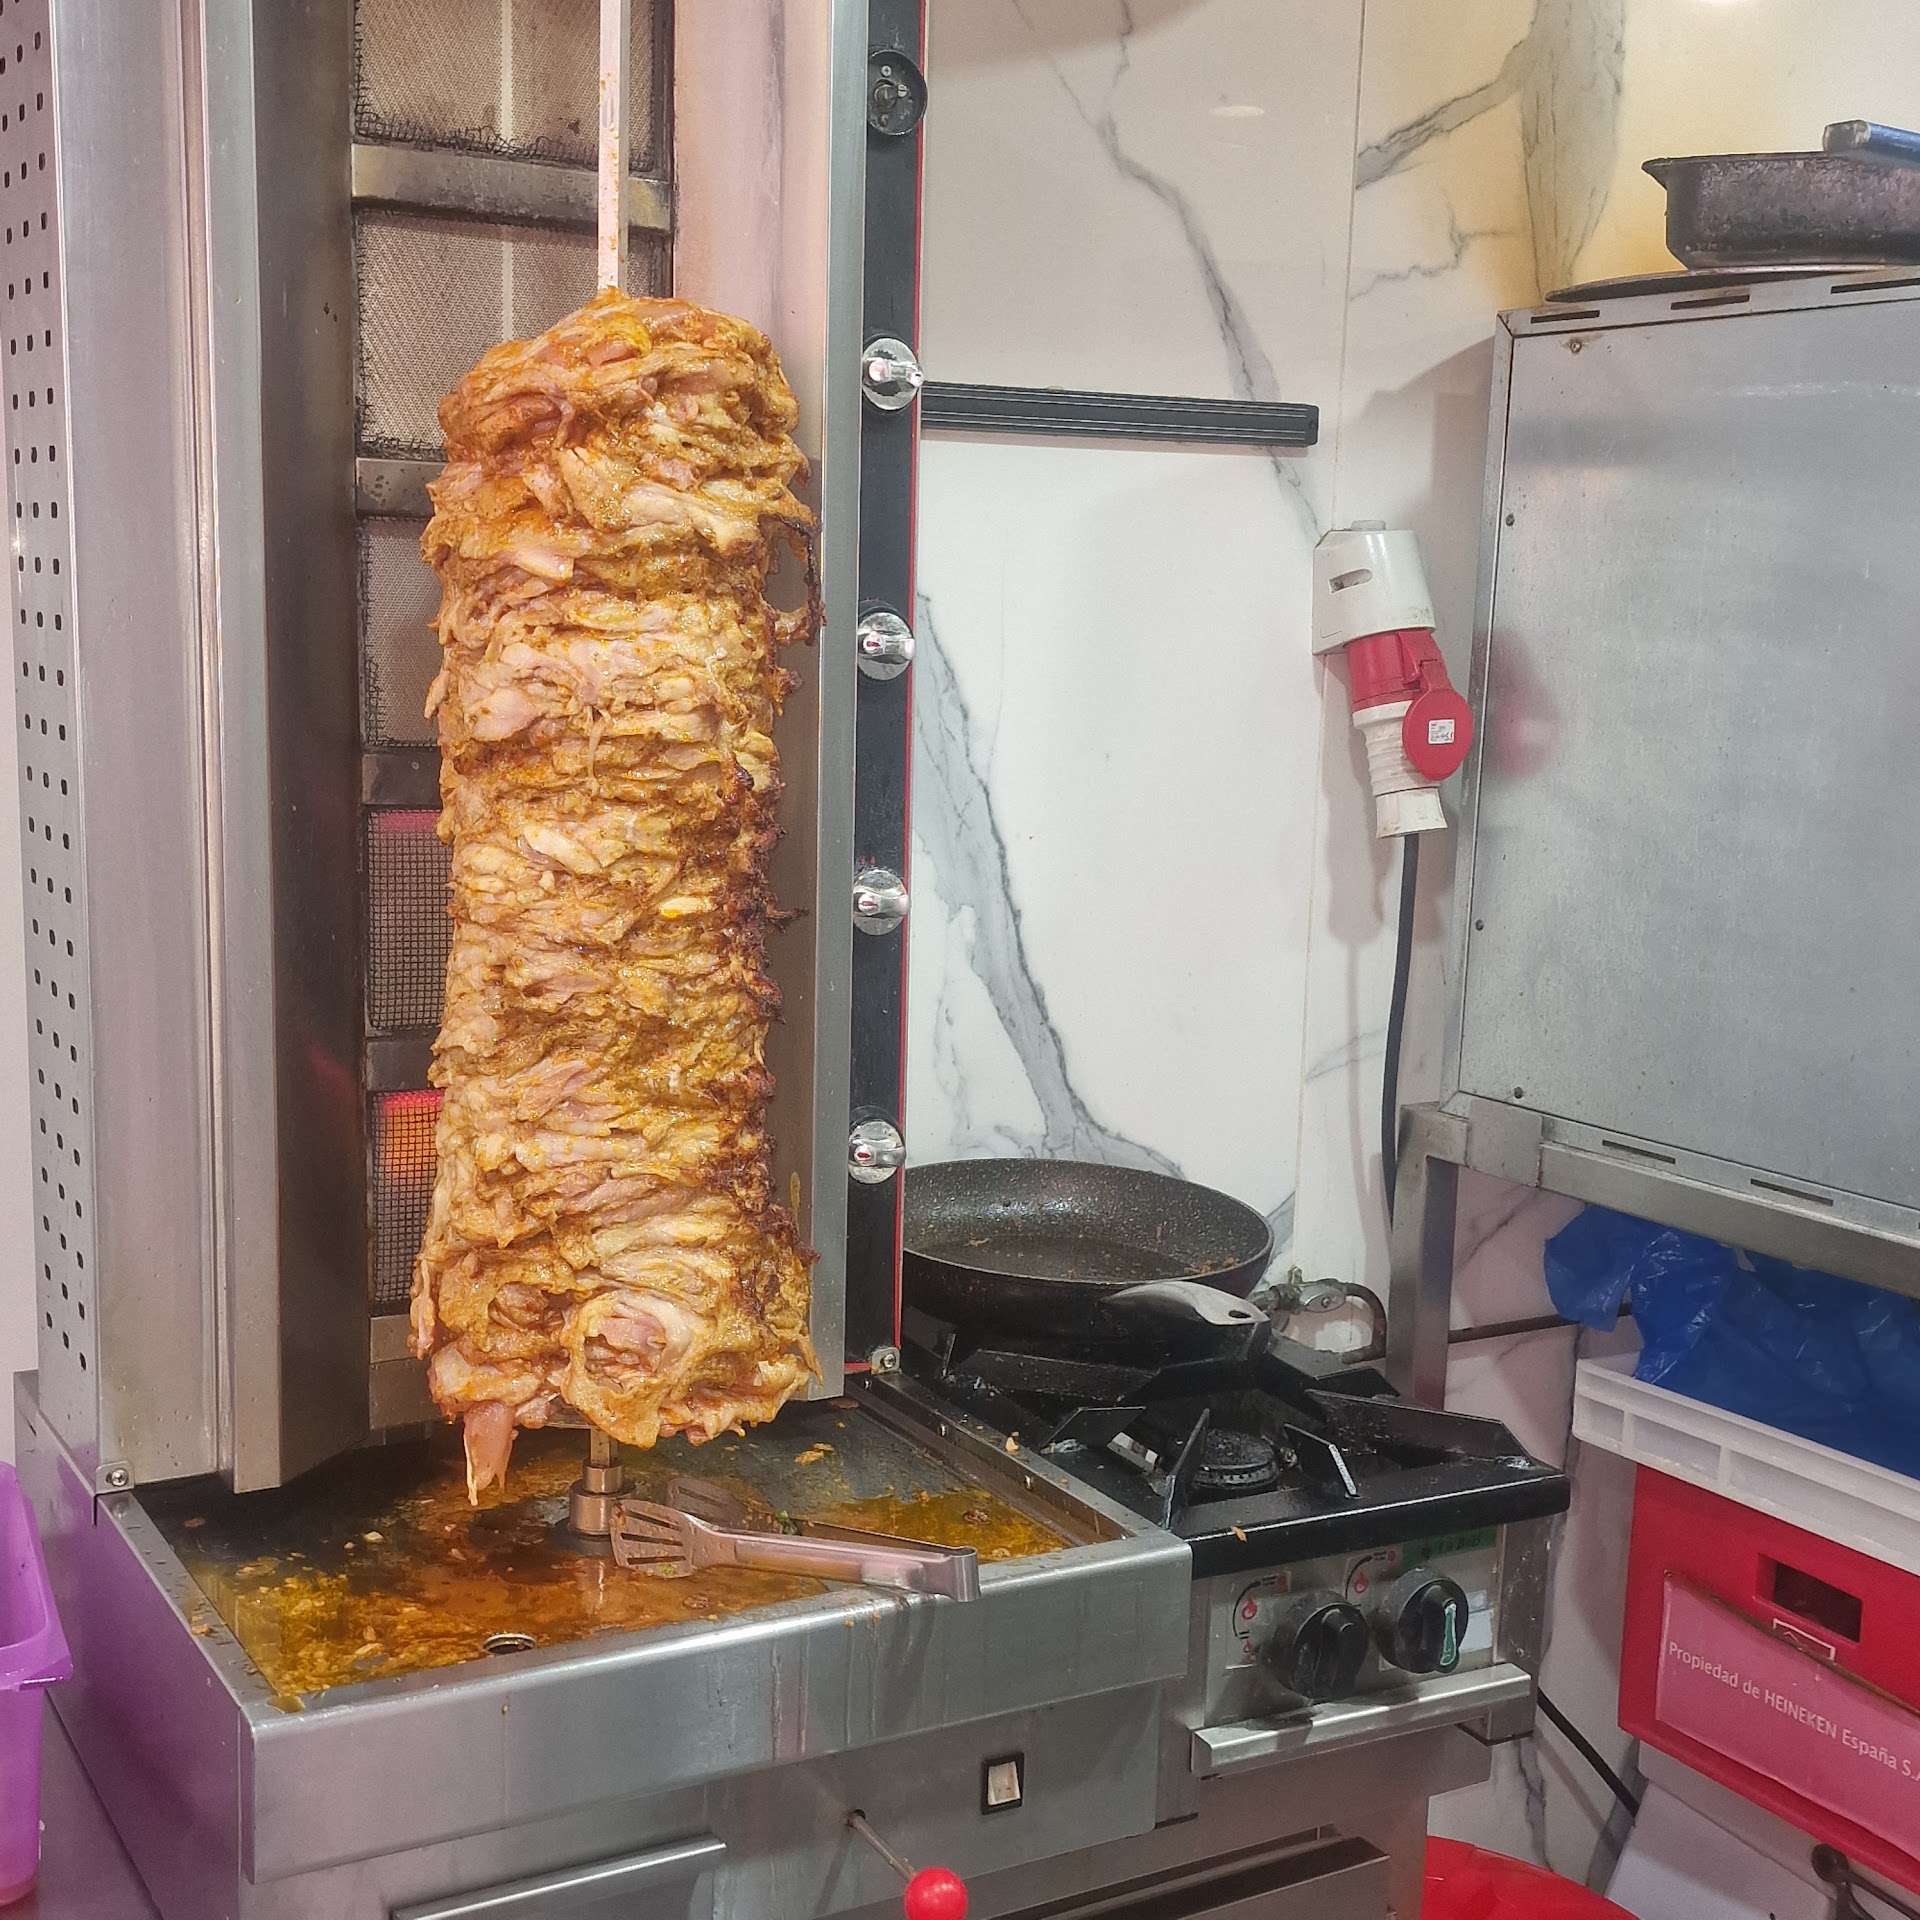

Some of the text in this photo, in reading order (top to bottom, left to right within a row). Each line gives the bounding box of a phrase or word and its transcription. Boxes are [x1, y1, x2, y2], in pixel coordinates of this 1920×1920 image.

[1669, 1641, 1738, 1688] Propiedad
[1742, 1680, 1760, 1699] de
[1764, 1689, 1837, 1739] HEINEKEN
[1842, 1728, 1897, 1770] España
